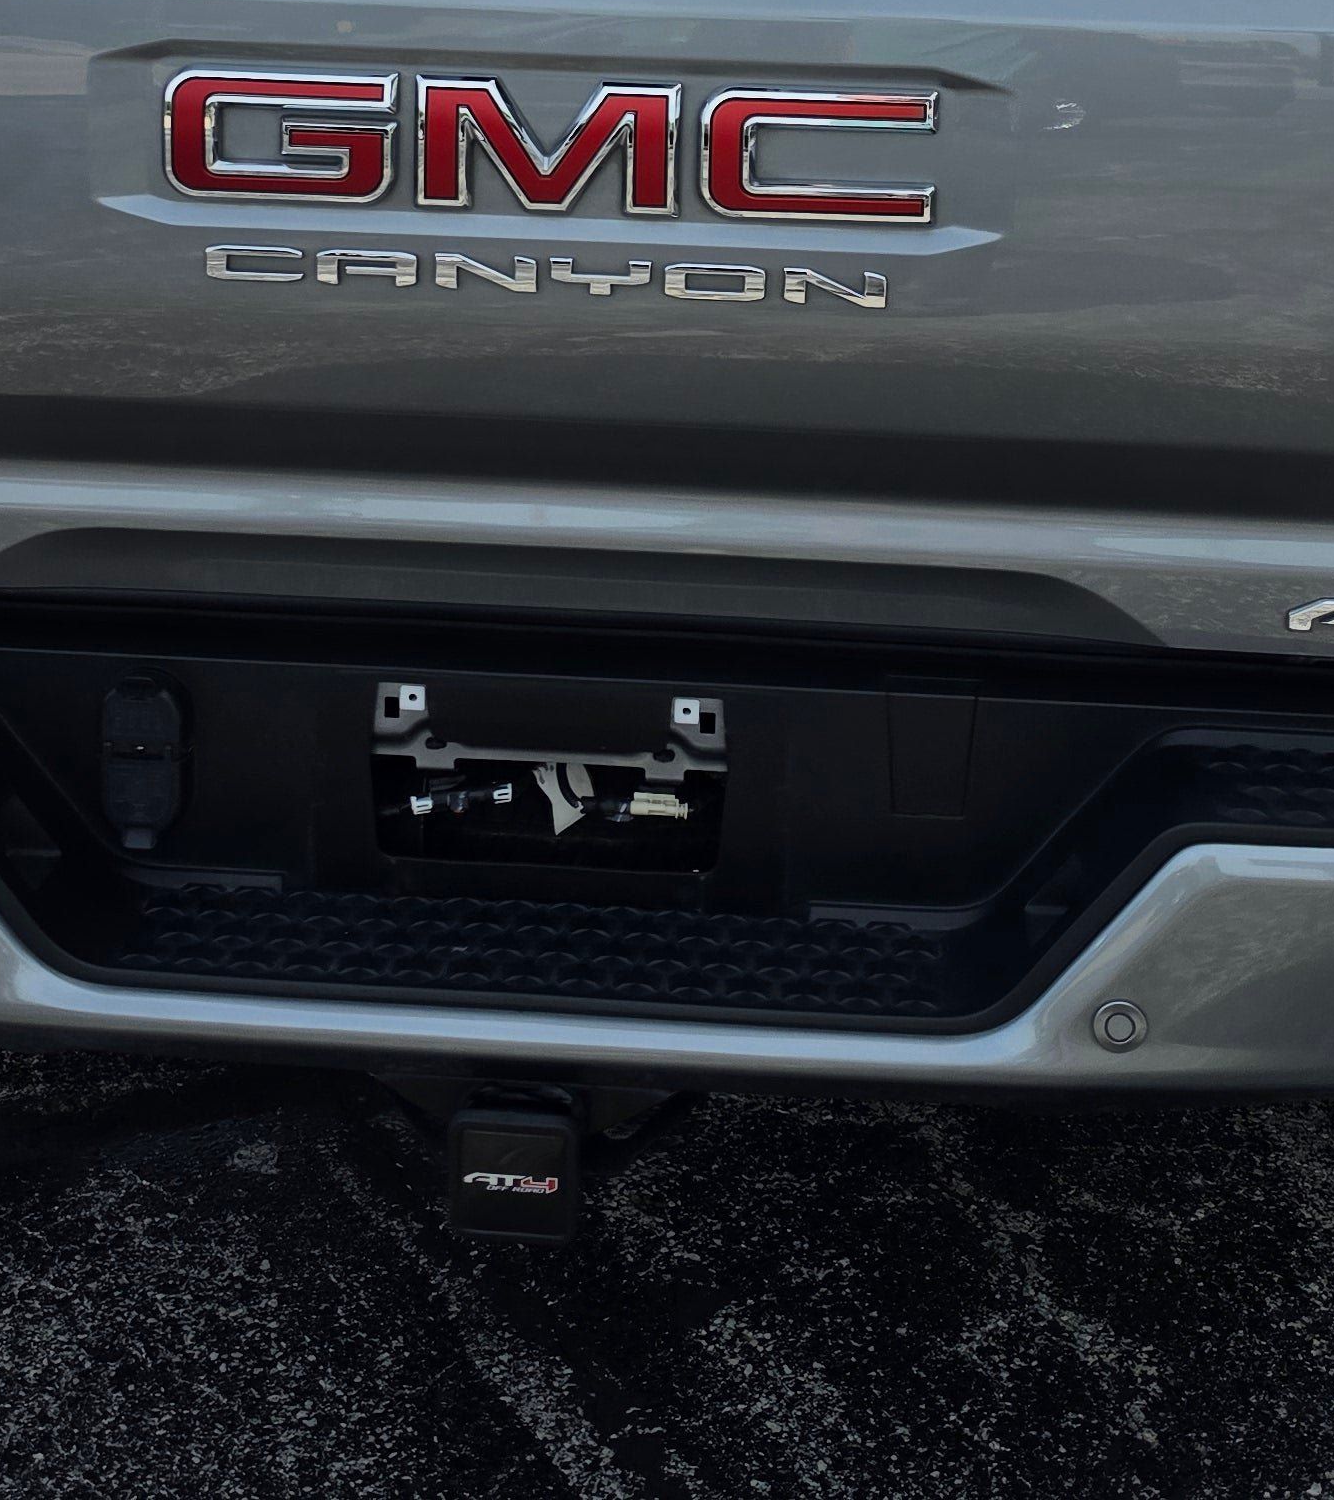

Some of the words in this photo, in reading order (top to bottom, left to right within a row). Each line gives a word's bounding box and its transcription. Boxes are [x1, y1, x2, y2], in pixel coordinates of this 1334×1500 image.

[163, 69, 939, 224] GMC
[204, 244, 888, 309] CANYON
[463, 1172, 559, 1194] AT4
[485, 1184, 509, 1192] OFF
[511, 1186, 545, 1194] ROAD
